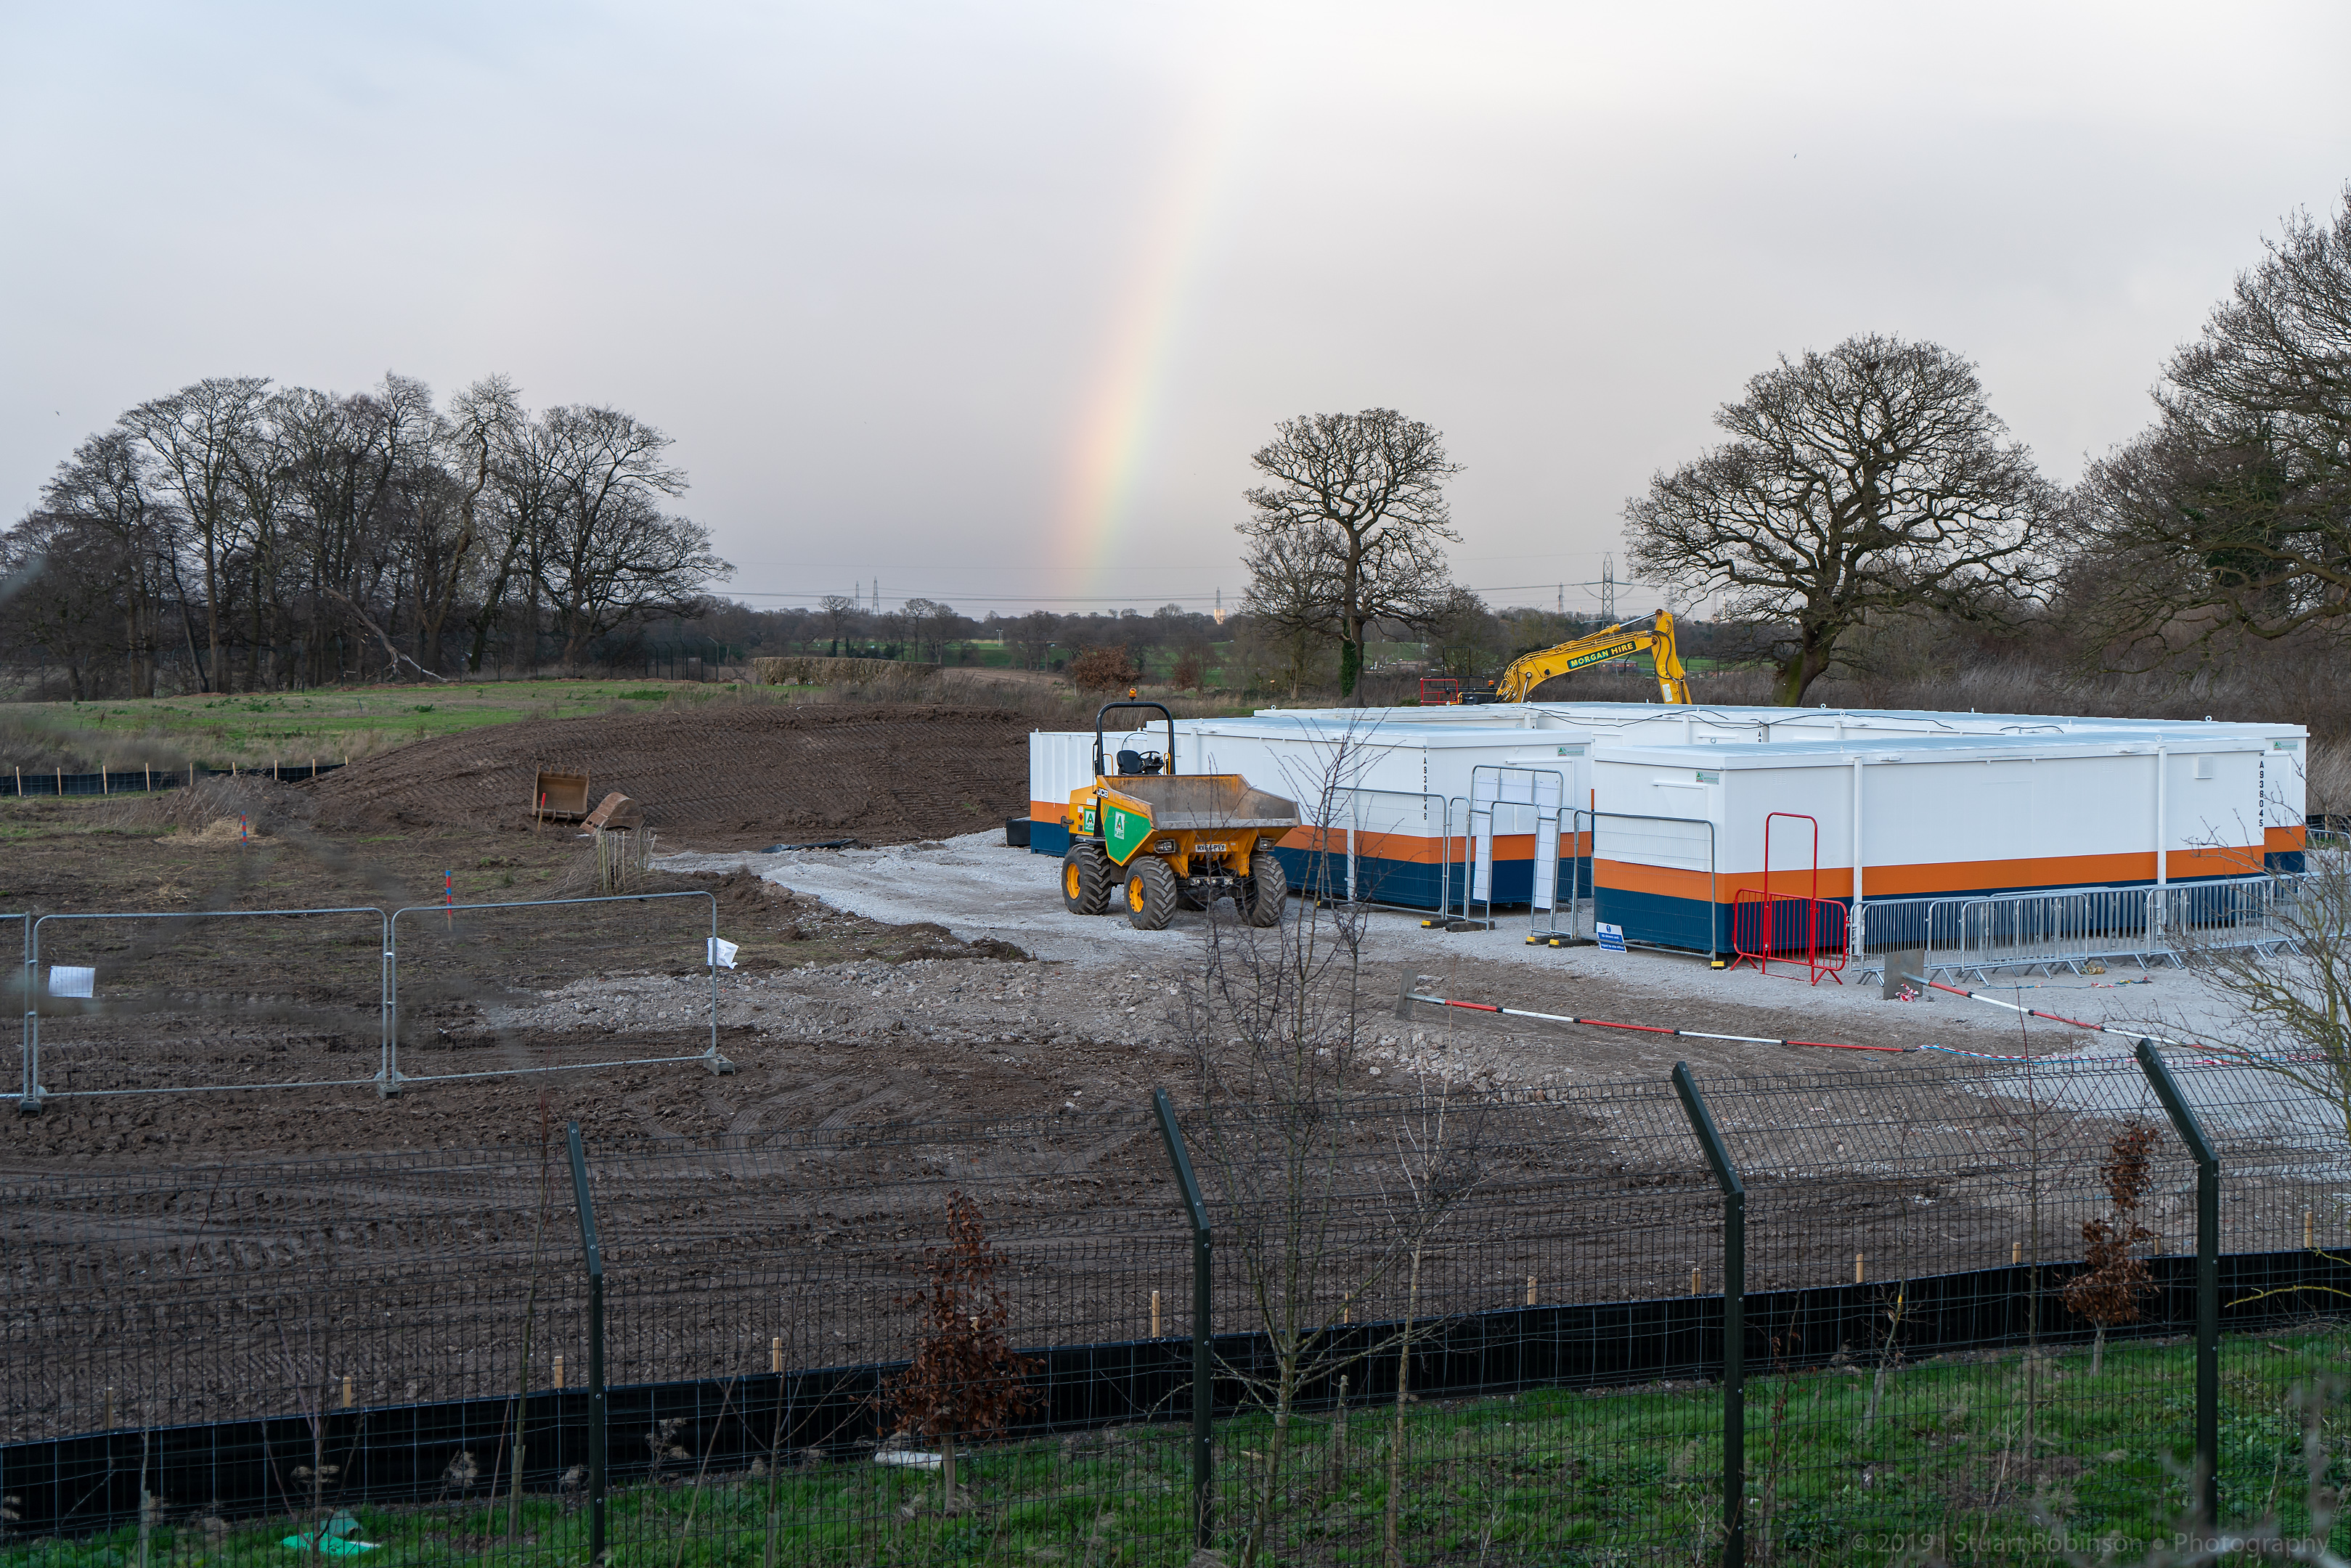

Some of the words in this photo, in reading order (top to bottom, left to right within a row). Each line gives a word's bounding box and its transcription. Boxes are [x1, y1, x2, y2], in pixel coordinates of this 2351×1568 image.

[1570, 650, 1609, 667] MORGAN
[1611, 642, 1634, 655] HIRE
[1097, 787, 1109, 799] JCB
